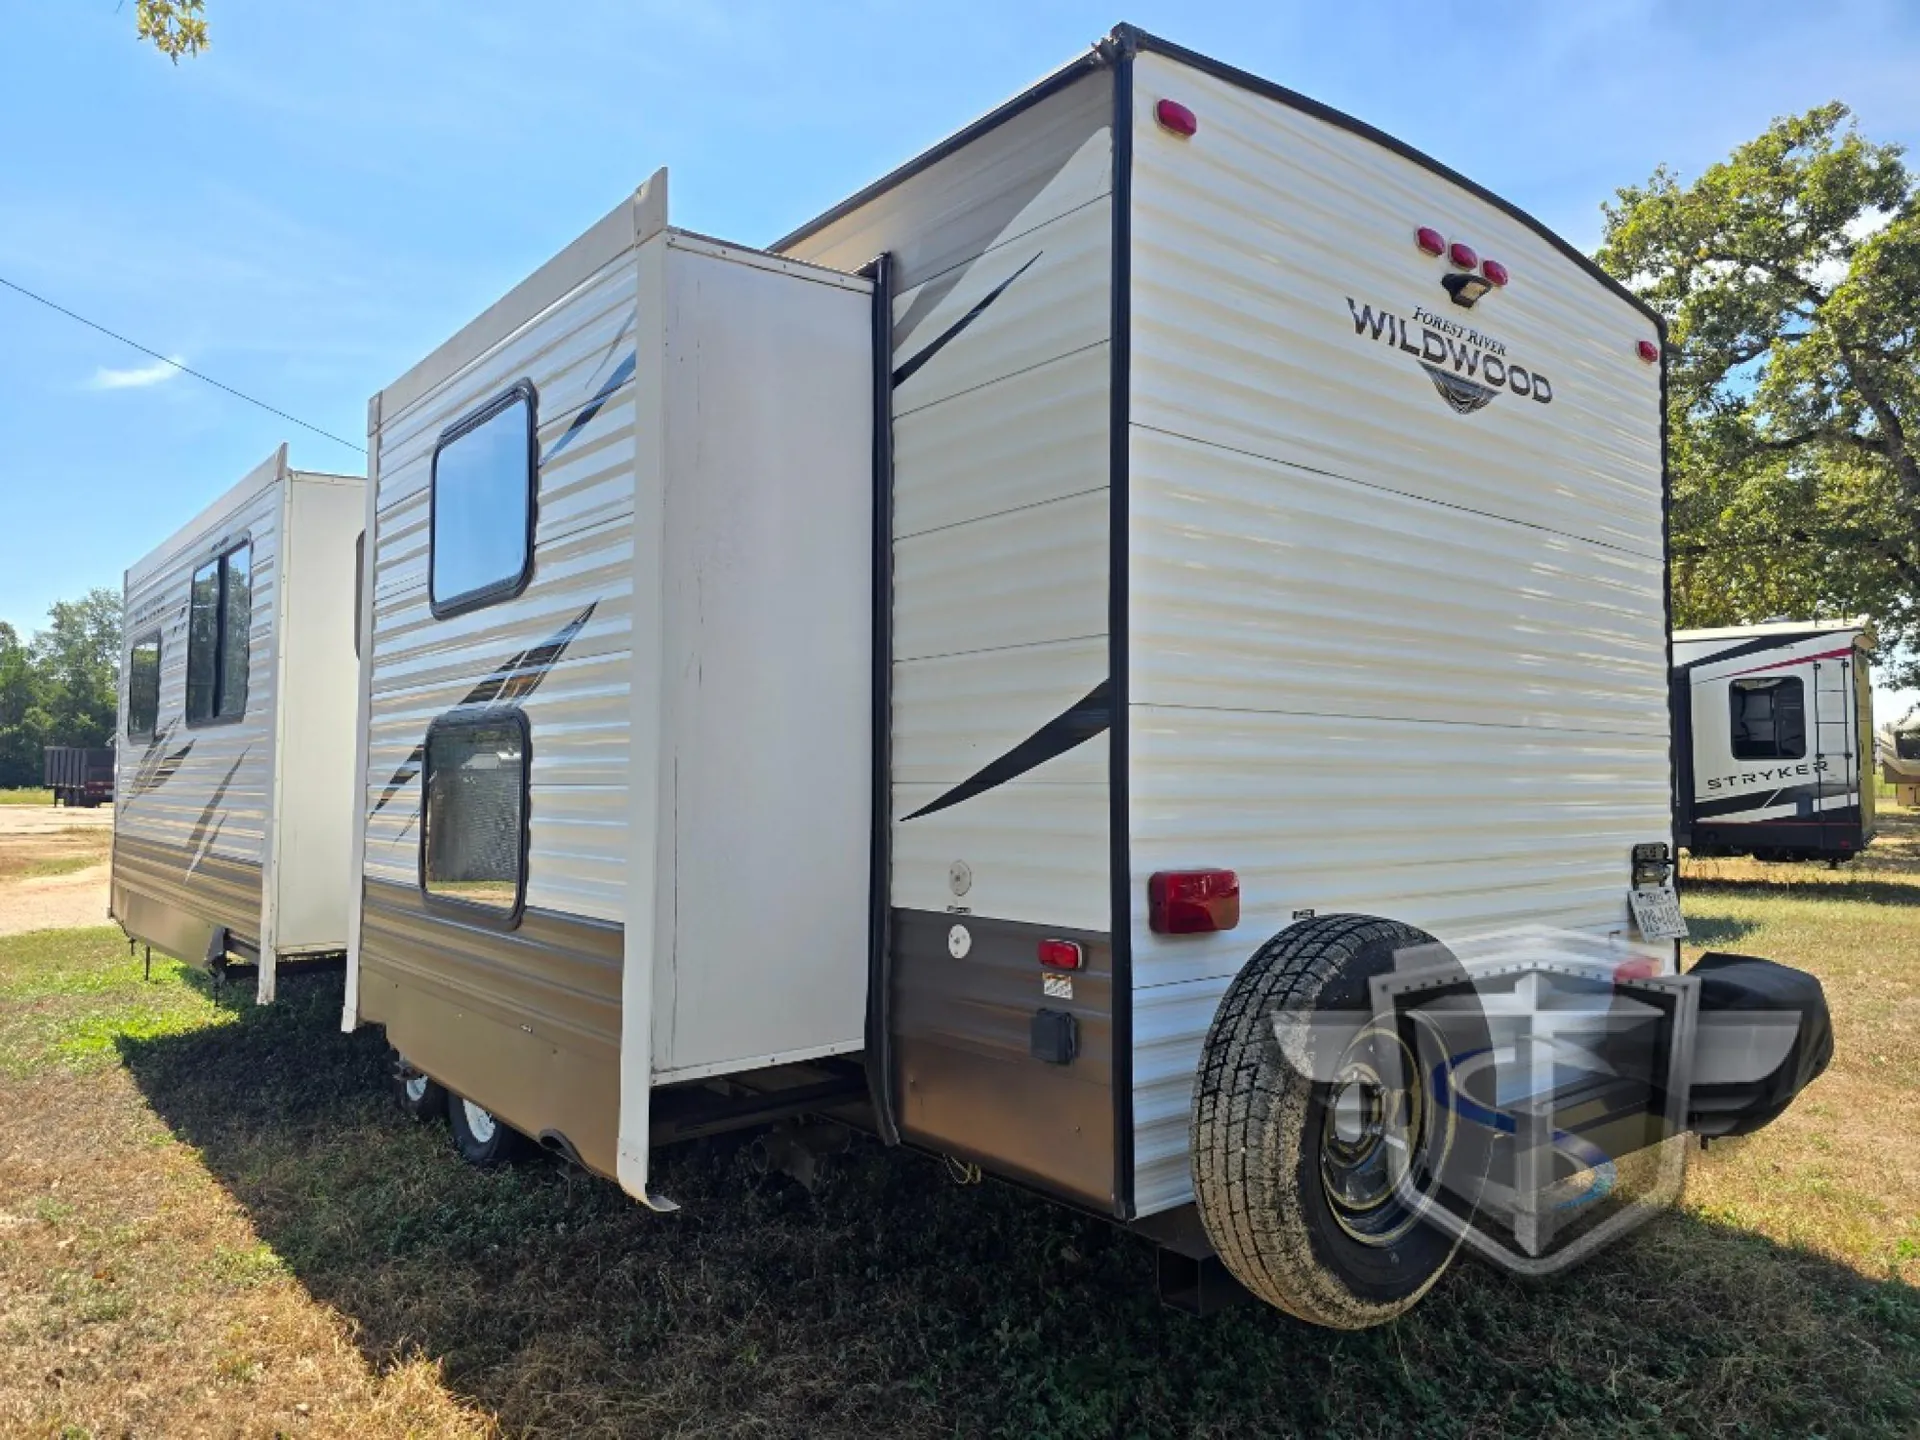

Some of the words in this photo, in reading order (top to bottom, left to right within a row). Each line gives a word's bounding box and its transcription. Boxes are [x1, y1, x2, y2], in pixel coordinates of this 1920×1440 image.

[1346, 296, 1553, 404] WILDWOOD
[1412, 305, 1465, 338] FOREST
[1467, 328, 1507, 357] RIVER
[1707, 760, 1829, 790] STRYKER
